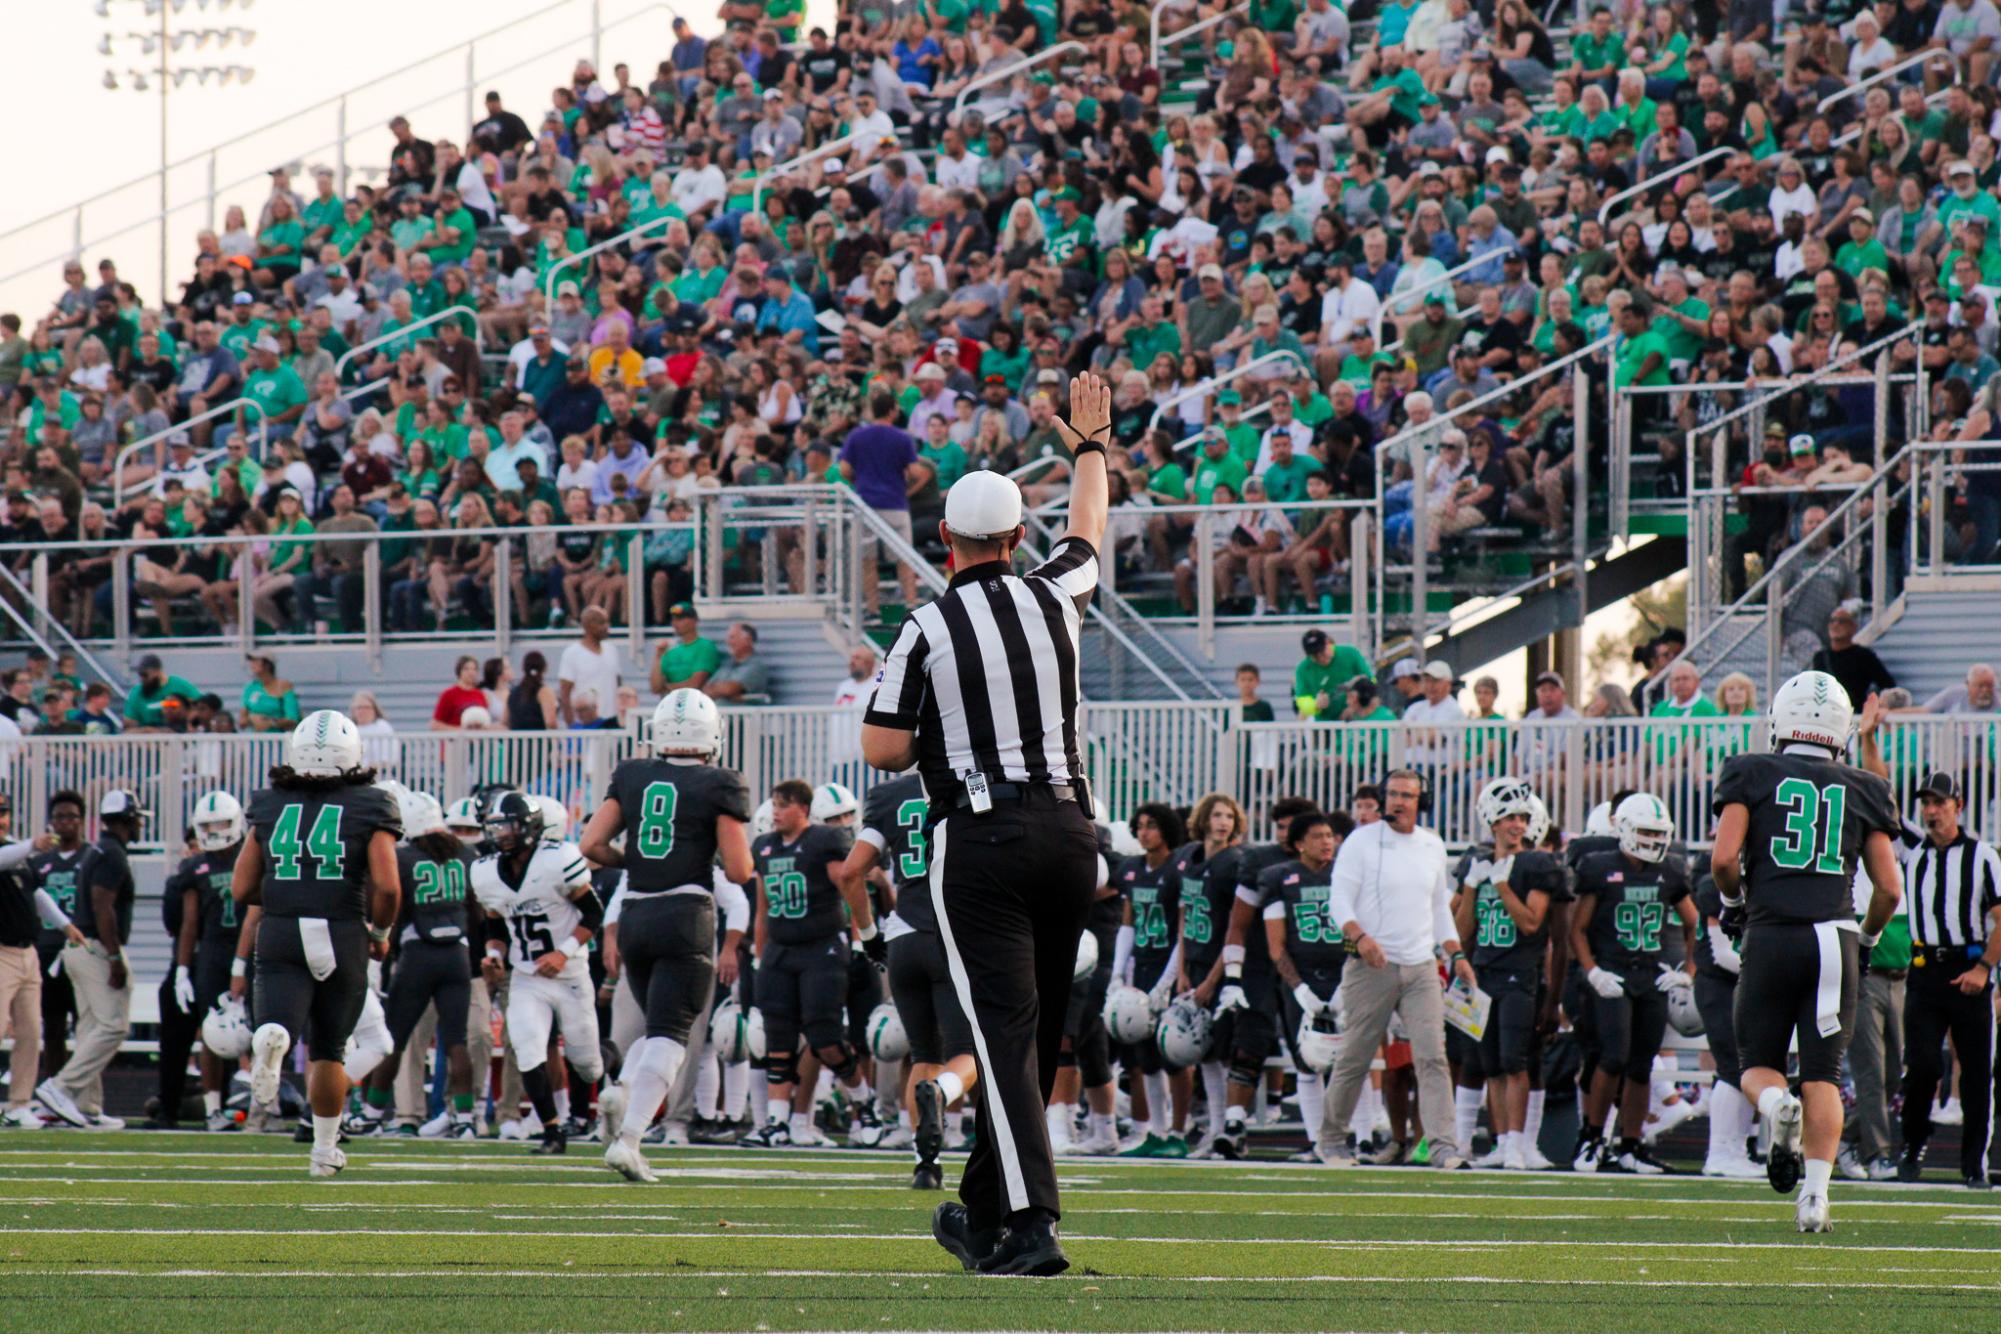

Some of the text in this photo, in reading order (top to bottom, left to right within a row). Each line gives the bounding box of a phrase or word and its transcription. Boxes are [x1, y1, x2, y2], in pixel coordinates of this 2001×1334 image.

[1792, 730, 1834, 745] Riddell
[269, 803, 346, 880] 44
[638, 781, 679, 859] 8
[1770, 777, 1846, 875] 31
[413, 858, 466, 905] 20
[764, 872, 808, 918] 50
[510, 913, 555, 962] 15
[1292, 901, 1344, 944] 53
[1614, 902, 1664, 951] 92
